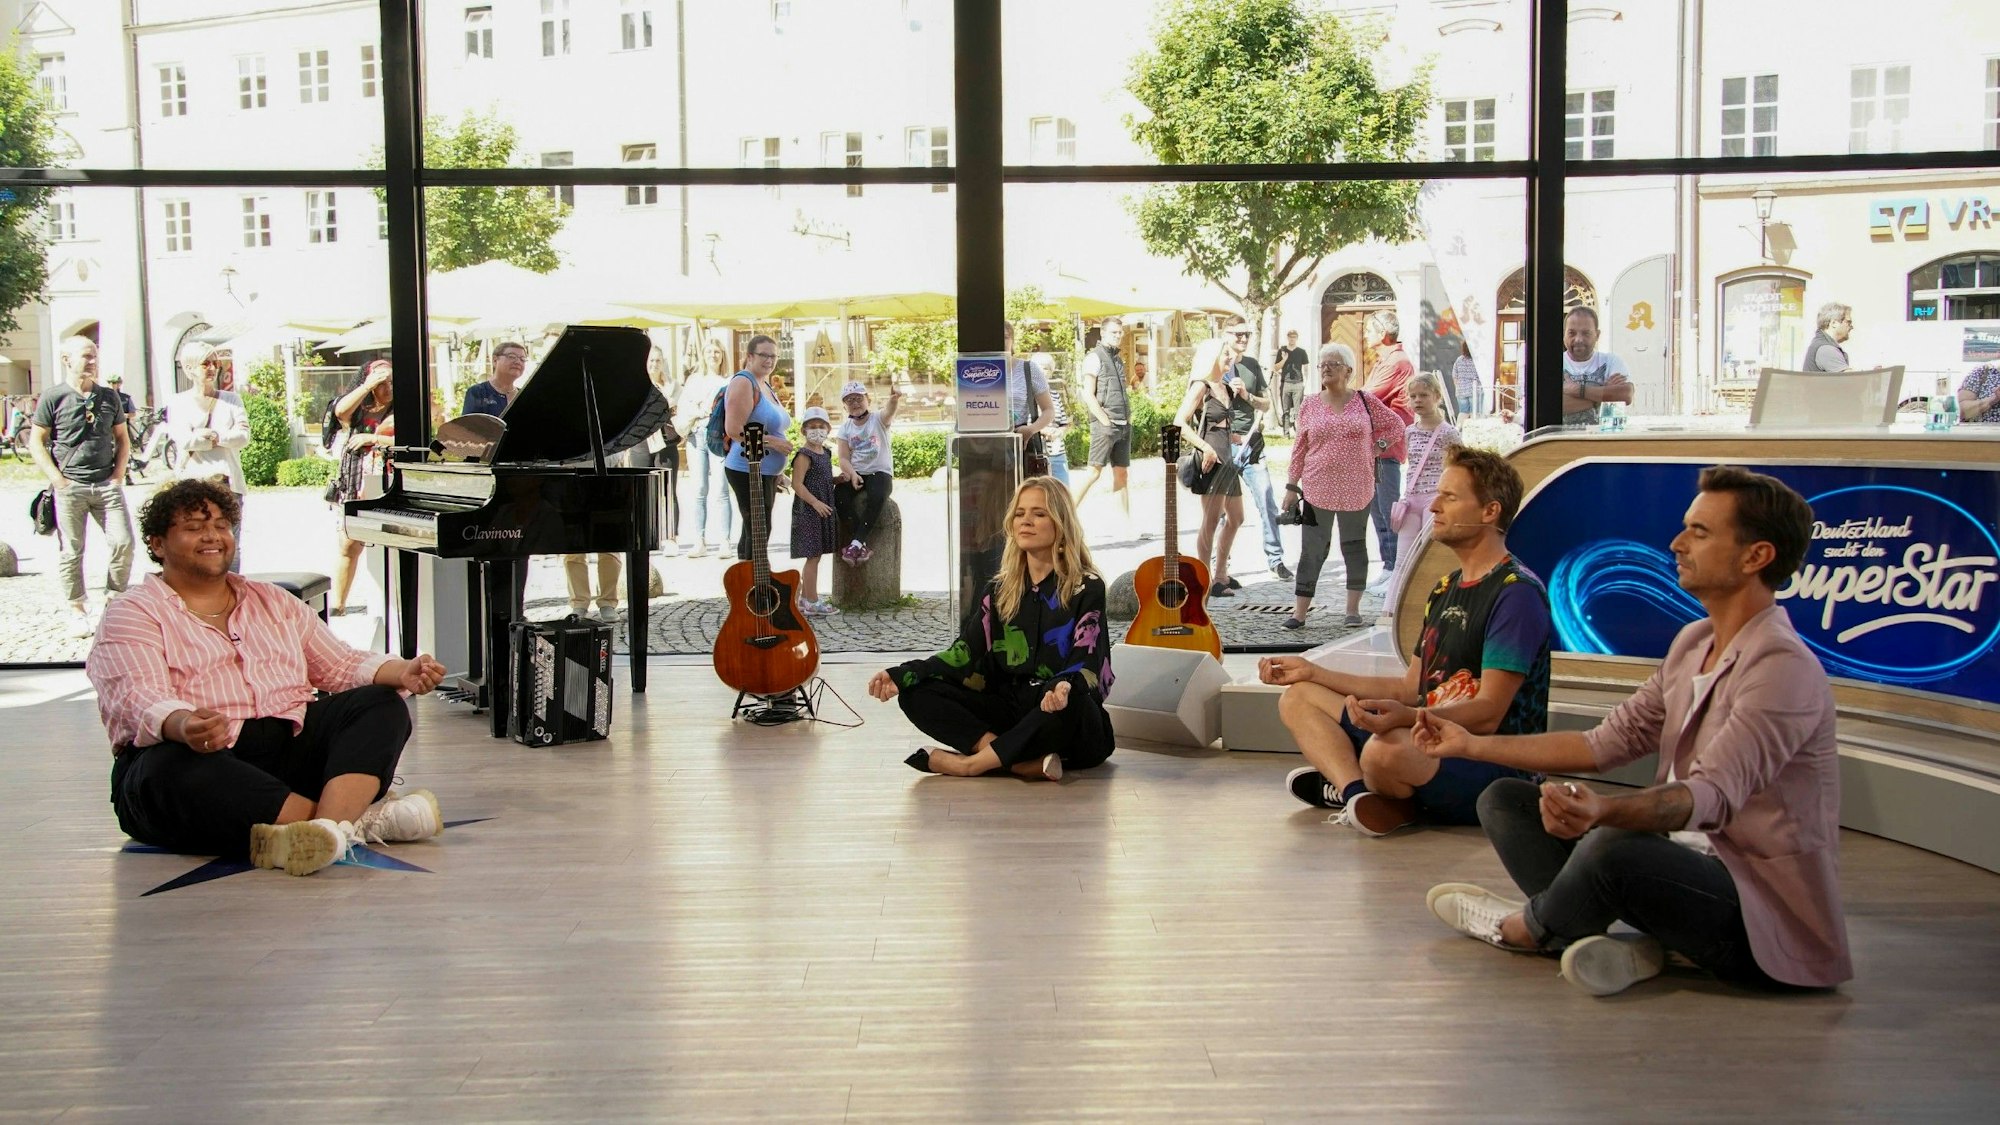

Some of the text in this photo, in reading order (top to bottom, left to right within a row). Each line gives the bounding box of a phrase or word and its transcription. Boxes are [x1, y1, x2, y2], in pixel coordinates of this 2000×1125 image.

[1729, 302, 1797, 313] APOTHEKE
[962, 368, 1000, 381] SuperStar
[965, 401, 1000, 409] RECALL
[461, 524, 522, 541] Clavinova
[1811, 515, 1913, 540] Deutschland
[1823, 541, 1888, 558] sucht den
